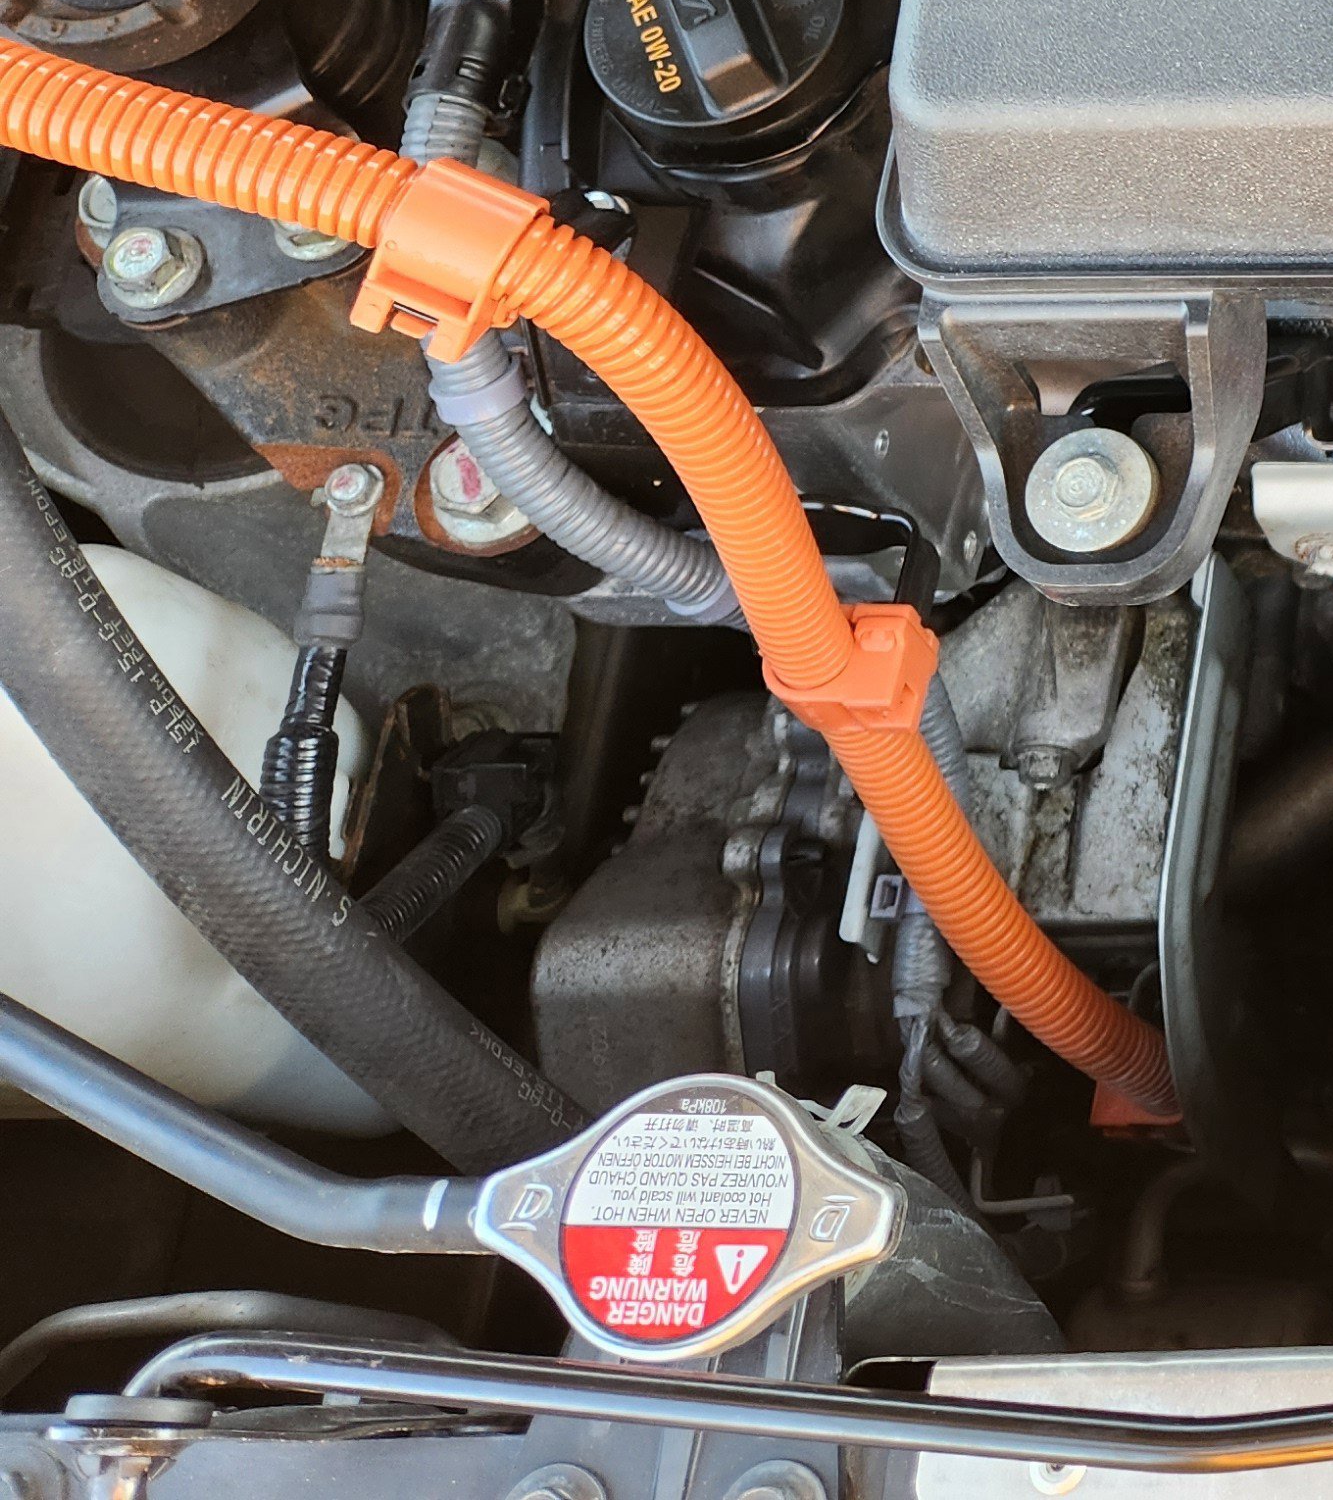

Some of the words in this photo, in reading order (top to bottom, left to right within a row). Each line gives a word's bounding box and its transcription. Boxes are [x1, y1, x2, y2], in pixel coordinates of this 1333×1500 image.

[639, 25, 682, 94] 0W-20
[680, 1097, 728, 1114] 108kPa
[644, 1153, 684, 1168] MOTOR
[684, 1153, 733, 1168] HEISSEM
[734, 1154, 752, 1168] BEI
[752, 1155, 787, 1169] NICHT
[587, 1169, 639, 1186] CHAUD.
[640, 1171, 689, 1187] QUAND
[691, 1172, 720, 1188] PAS
[720, 1173, 789, 1188] N'OUVREZ
[610, 1188, 638, 1201] you.
[639, 1189, 673, 1204] scald
[677, 1190, 698, 1204] will
[700, 1190, 747, 1206] coolant
[749, 1192, 773, 1207] Hot
[591, 1206, 627, 1221] HOT.
[629, 1207, 671, 1222] WHEN
[675, 1208, 719, 1224] OPEN
[720, 1209, 769, 1224] NEVER
[589, 1275, 709, 1301] WARNUNG
[606, 1300, 707, 1327] DANGER
